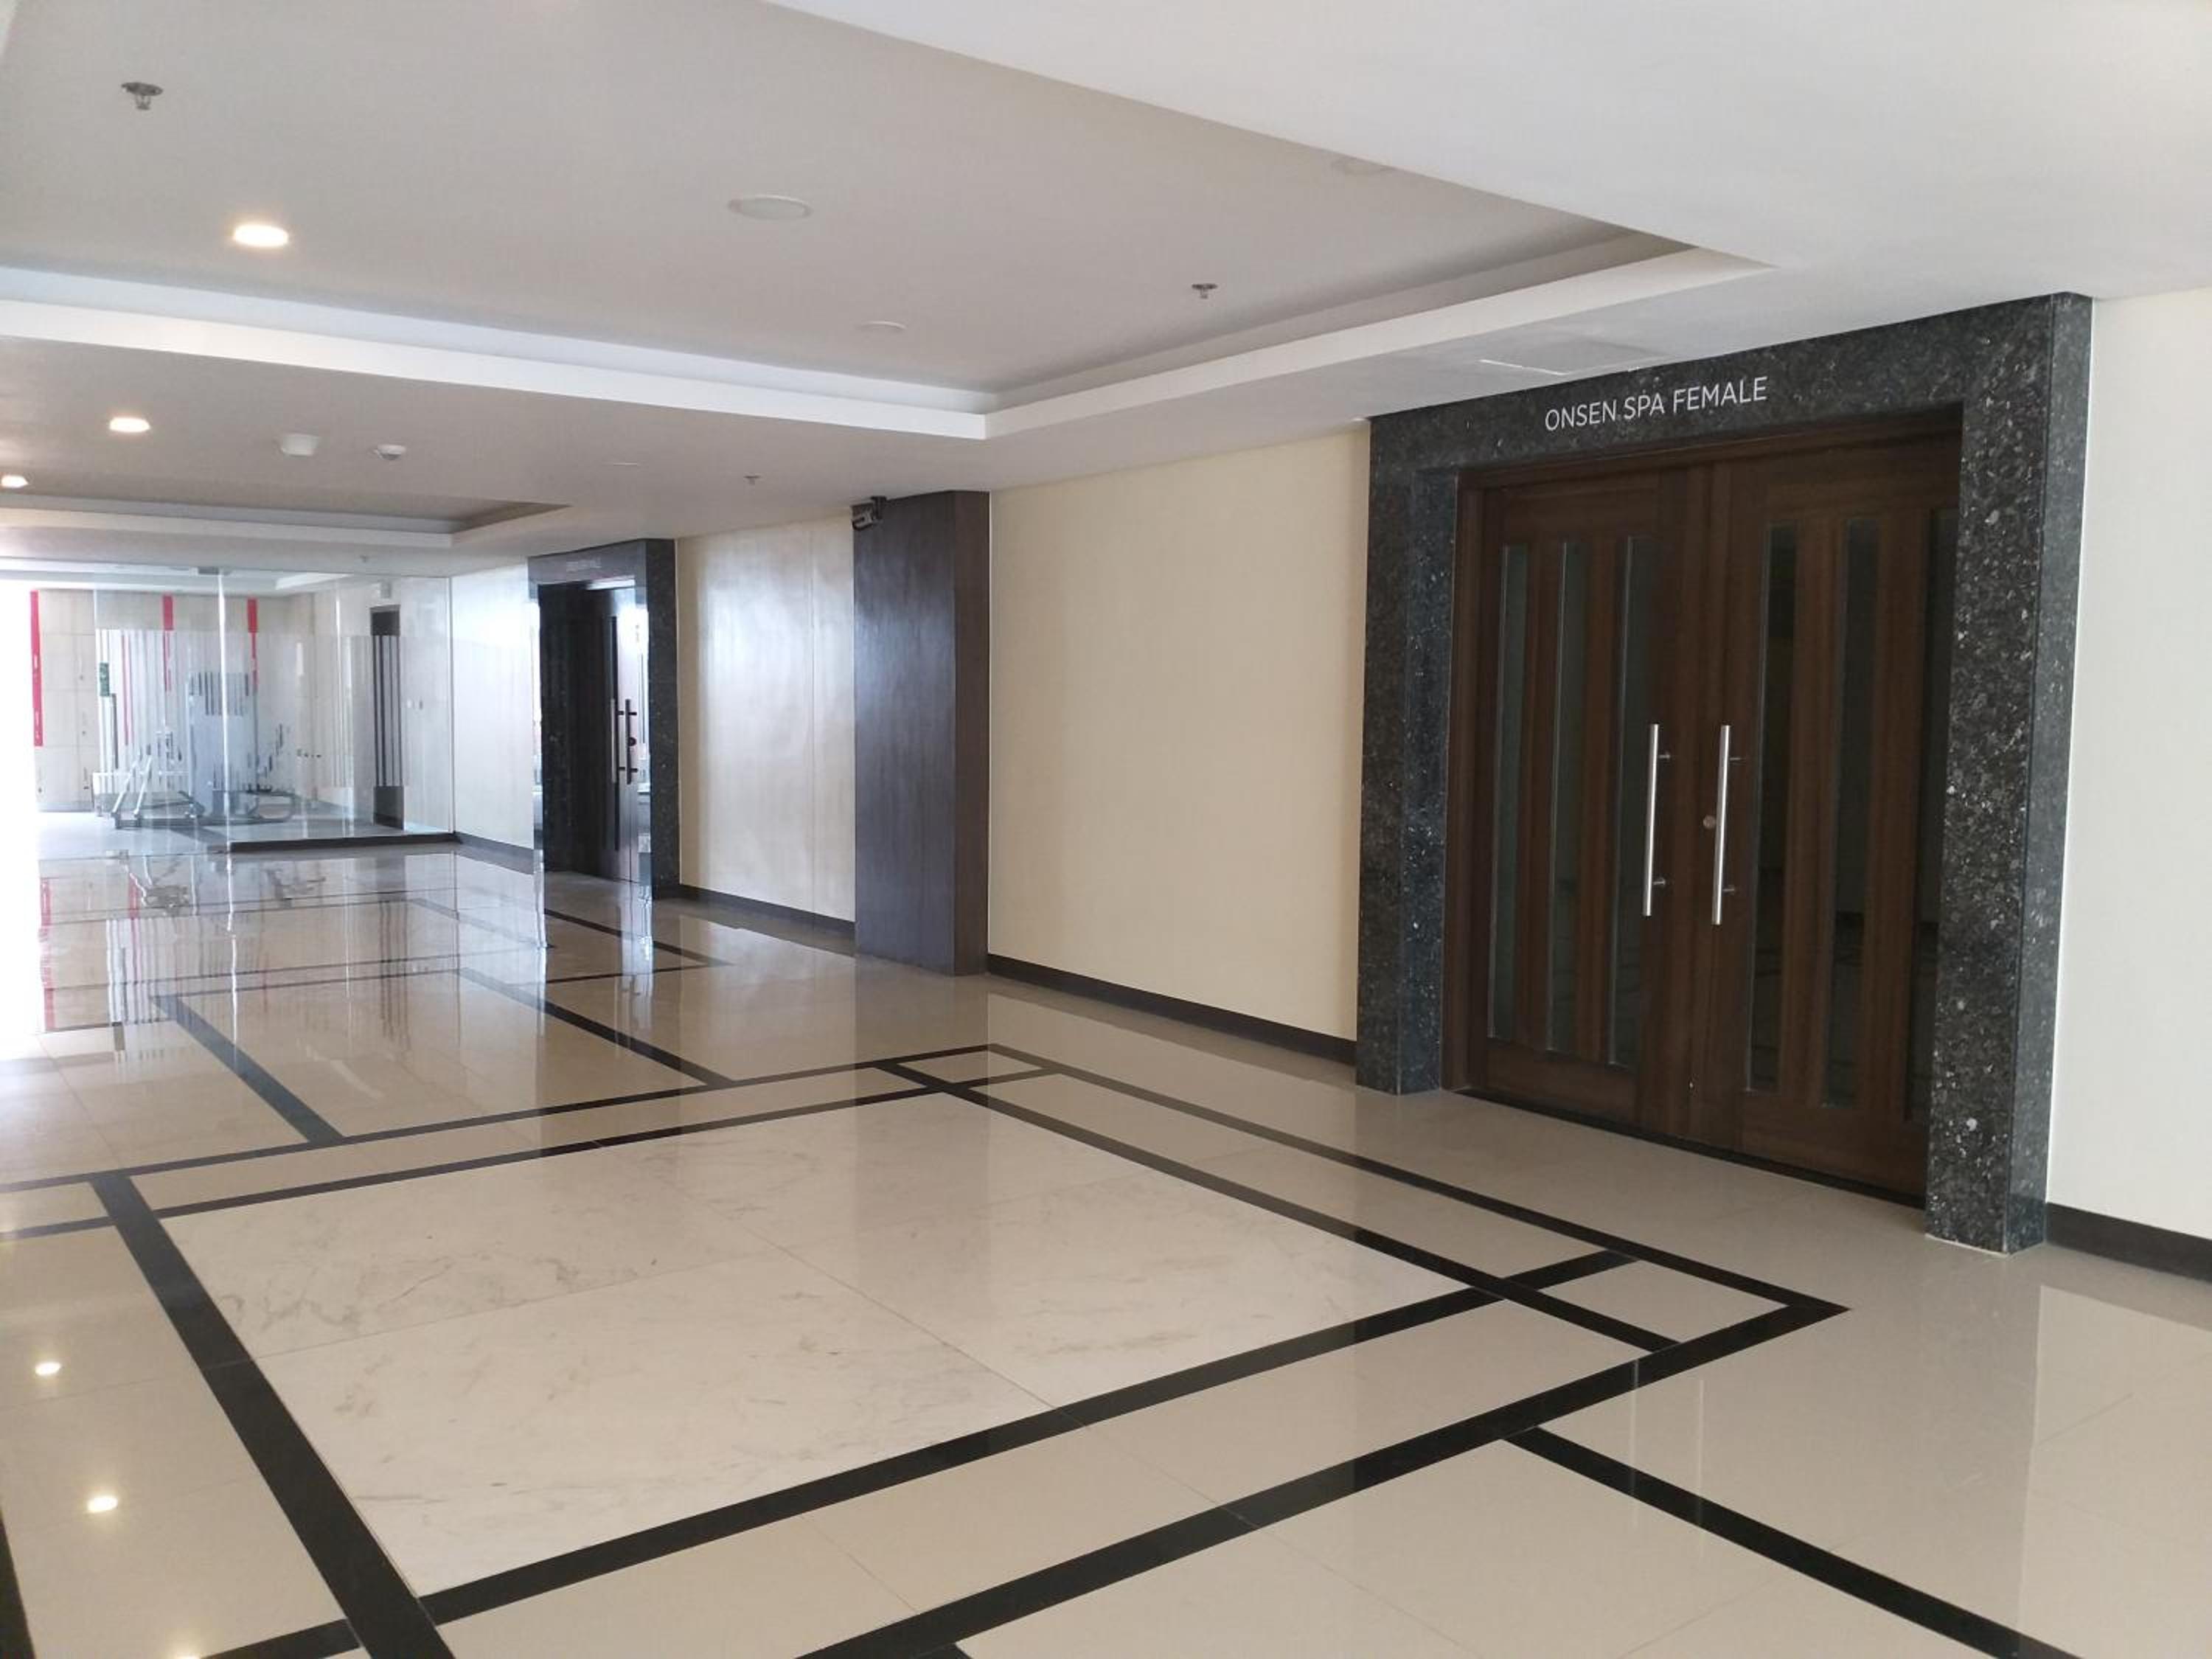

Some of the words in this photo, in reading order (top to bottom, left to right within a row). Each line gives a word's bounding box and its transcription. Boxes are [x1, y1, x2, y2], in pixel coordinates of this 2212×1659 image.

[1545, 400, 1617, 431] ONSEN
[1623, 392, 1665, 420] SPA
[1672, 375, 1768, 414] FEMALE
